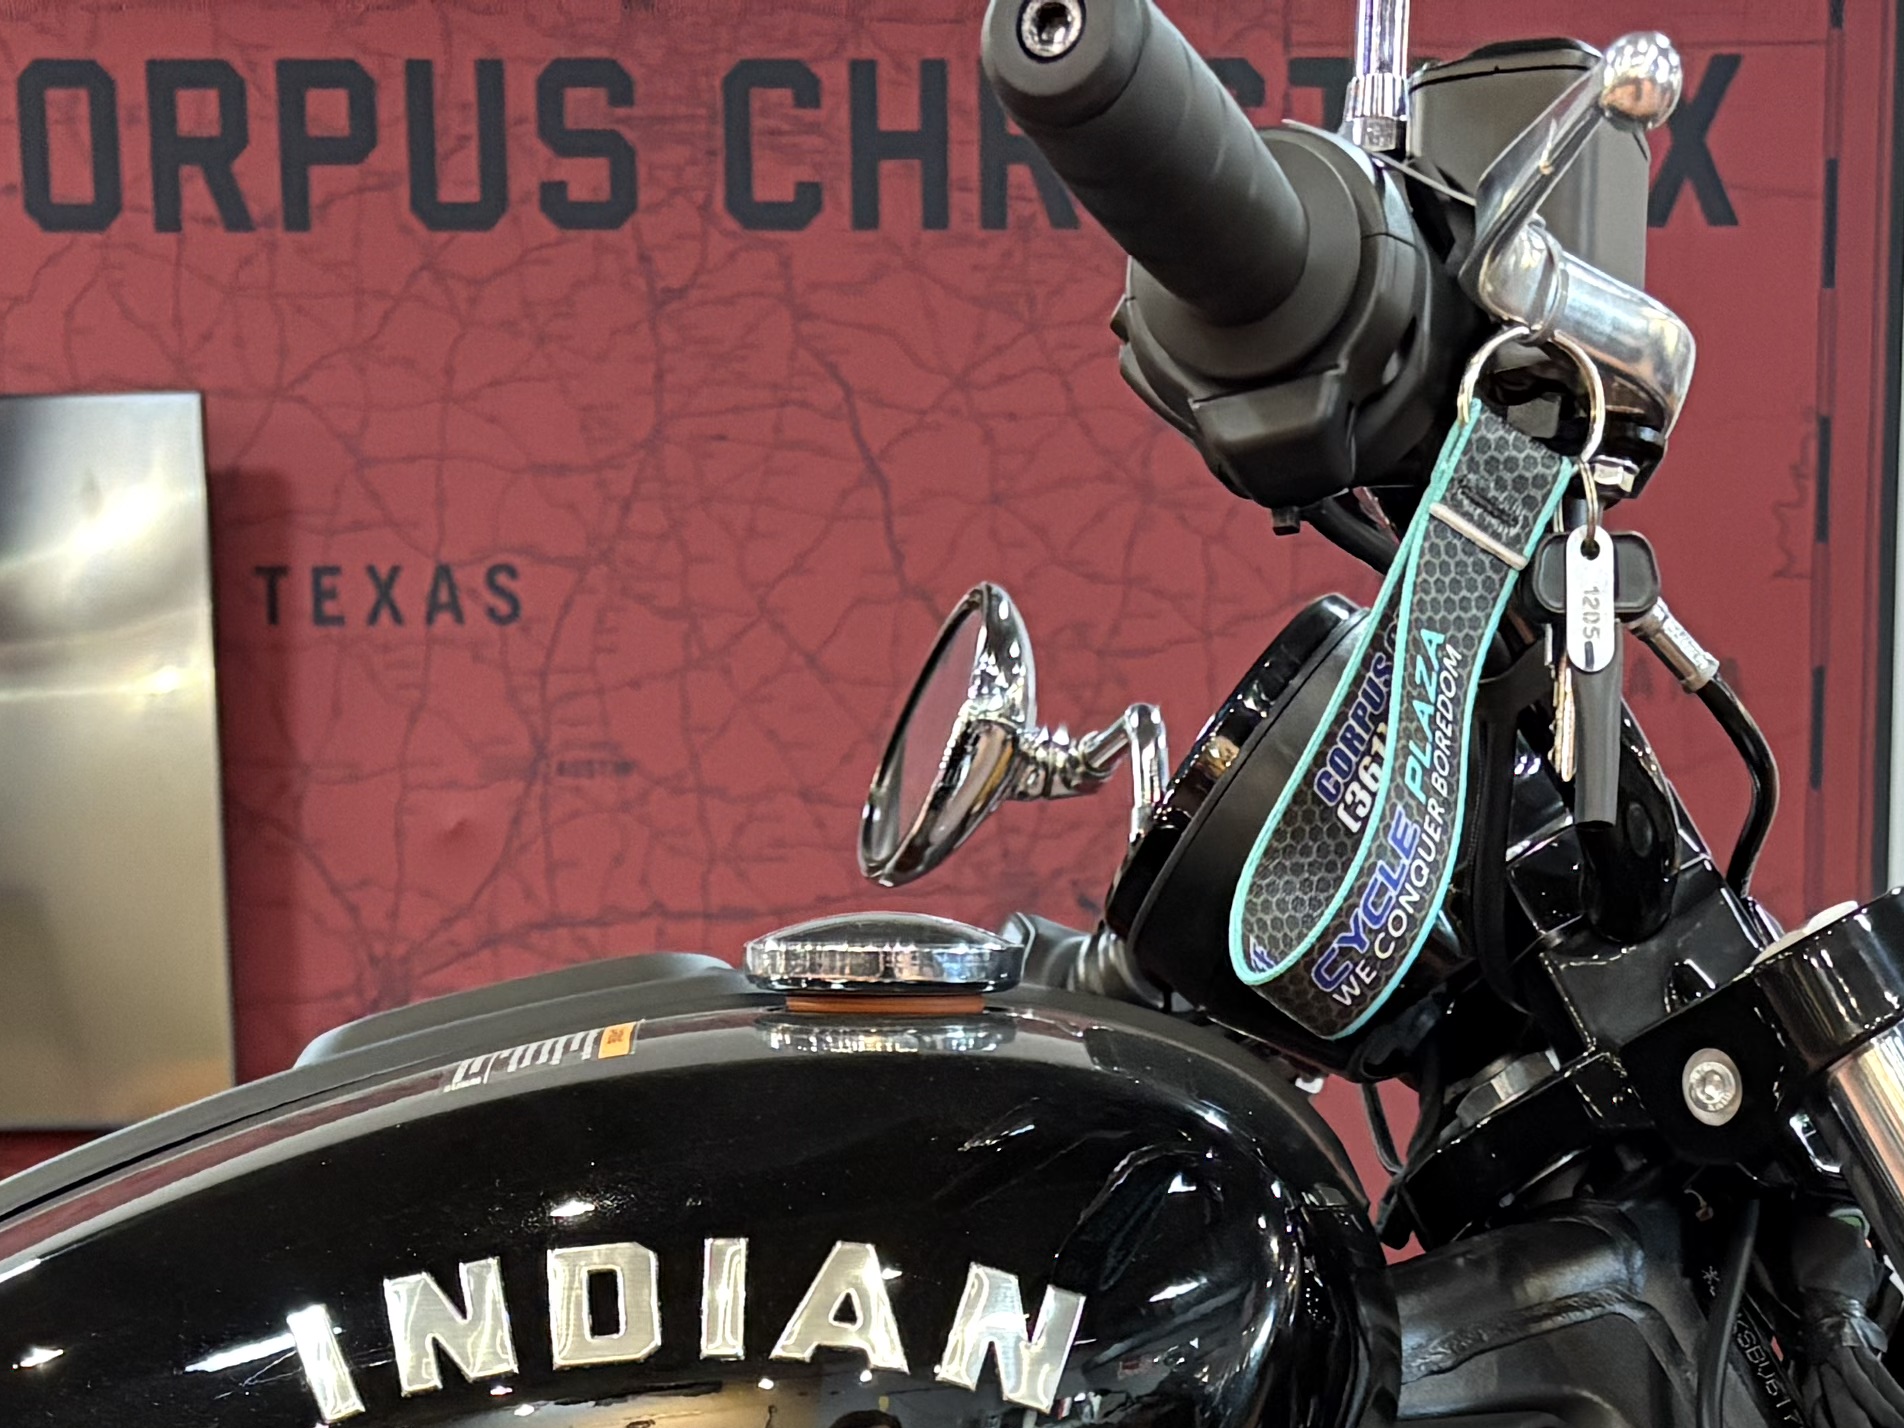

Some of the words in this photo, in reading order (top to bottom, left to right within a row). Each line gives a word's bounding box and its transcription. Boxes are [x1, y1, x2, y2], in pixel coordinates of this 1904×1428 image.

[254, 561, 524, 631] TEXAS
[1311, 808, 1423, 993] CYCLE
[1404, 627, 1448, 806] PLAZA
[1314, 650, 1395, 808] CORPUS
[1332, 957, 1379, 1009] WE
[1376, 801, 1446, 958] CONQUER
[1431, 642, 1464, 800] BOREDOM
[286, 1235, 1087, 1425] INDIAN
